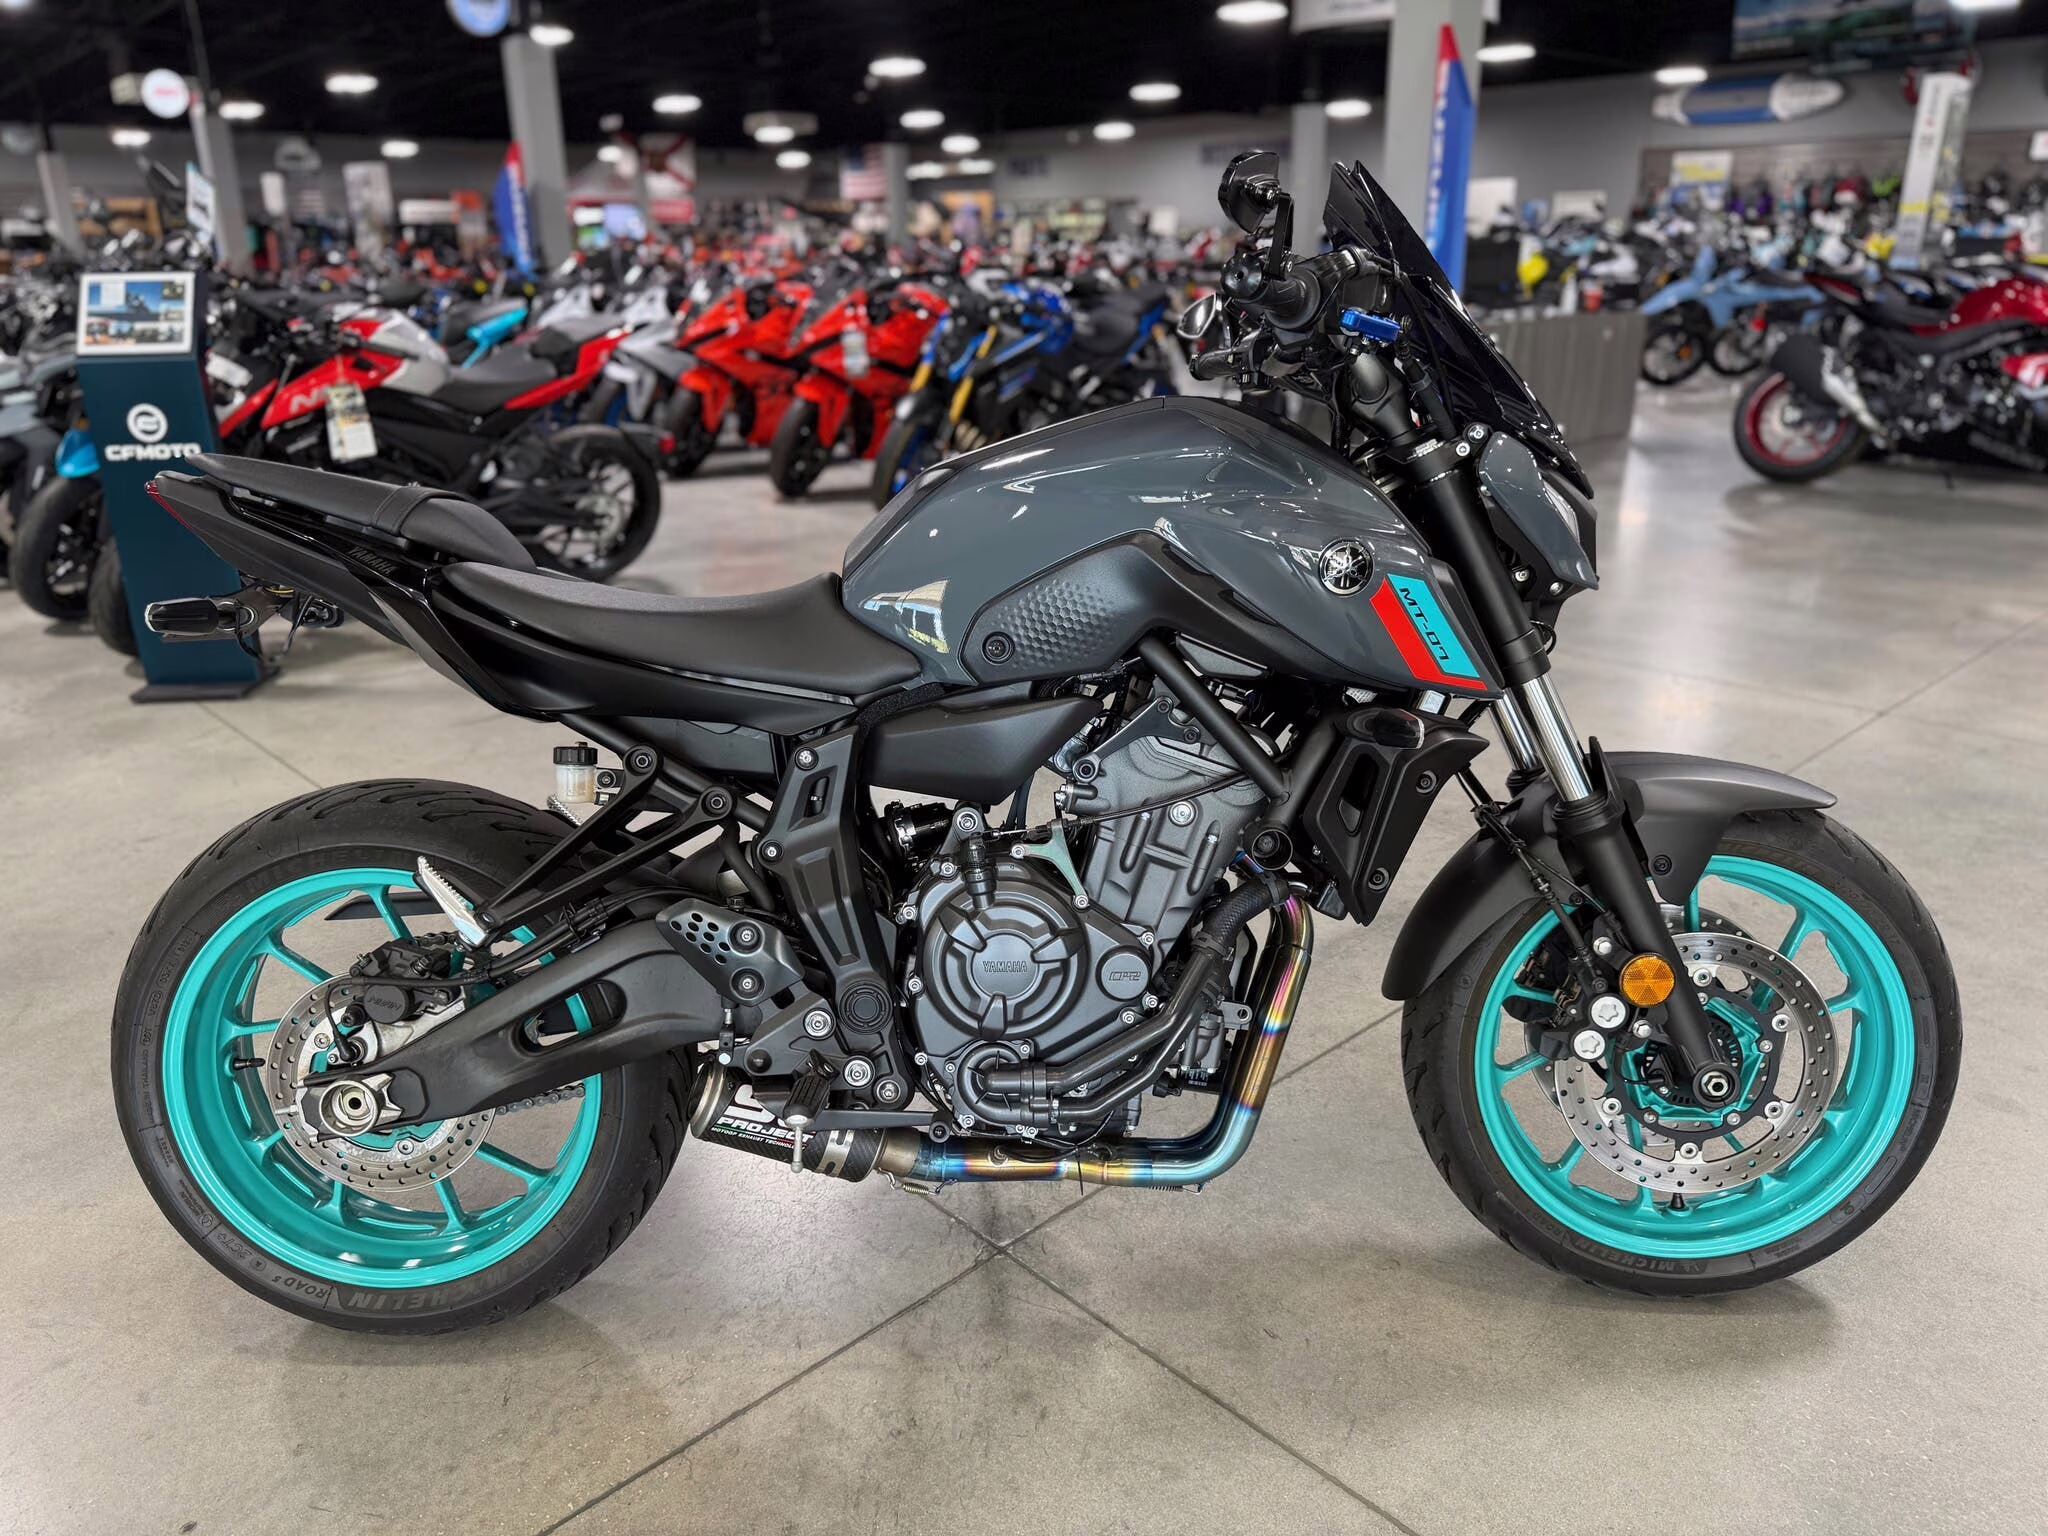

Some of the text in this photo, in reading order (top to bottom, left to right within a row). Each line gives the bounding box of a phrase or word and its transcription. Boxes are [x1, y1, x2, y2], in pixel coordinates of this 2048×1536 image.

[104, 443, 202, 461] CFMOTO
[346, 546, 398, 575] YAMAHA
[1399, 587, 1450, 661] MT-07
[982, 960, 1028, 973] YAMAHA
[1108, 971, 1142, 981] CP2
[716, 1117, 815, 1142] PROJECT
[738, 1133, 764, 1143] EXHAUST
[1576, 1236, 1674, 1272] MICHELIN
[284, 1276, 328, 1299] ROAD
[349, 1264, 512, 1310] MICHELIN
